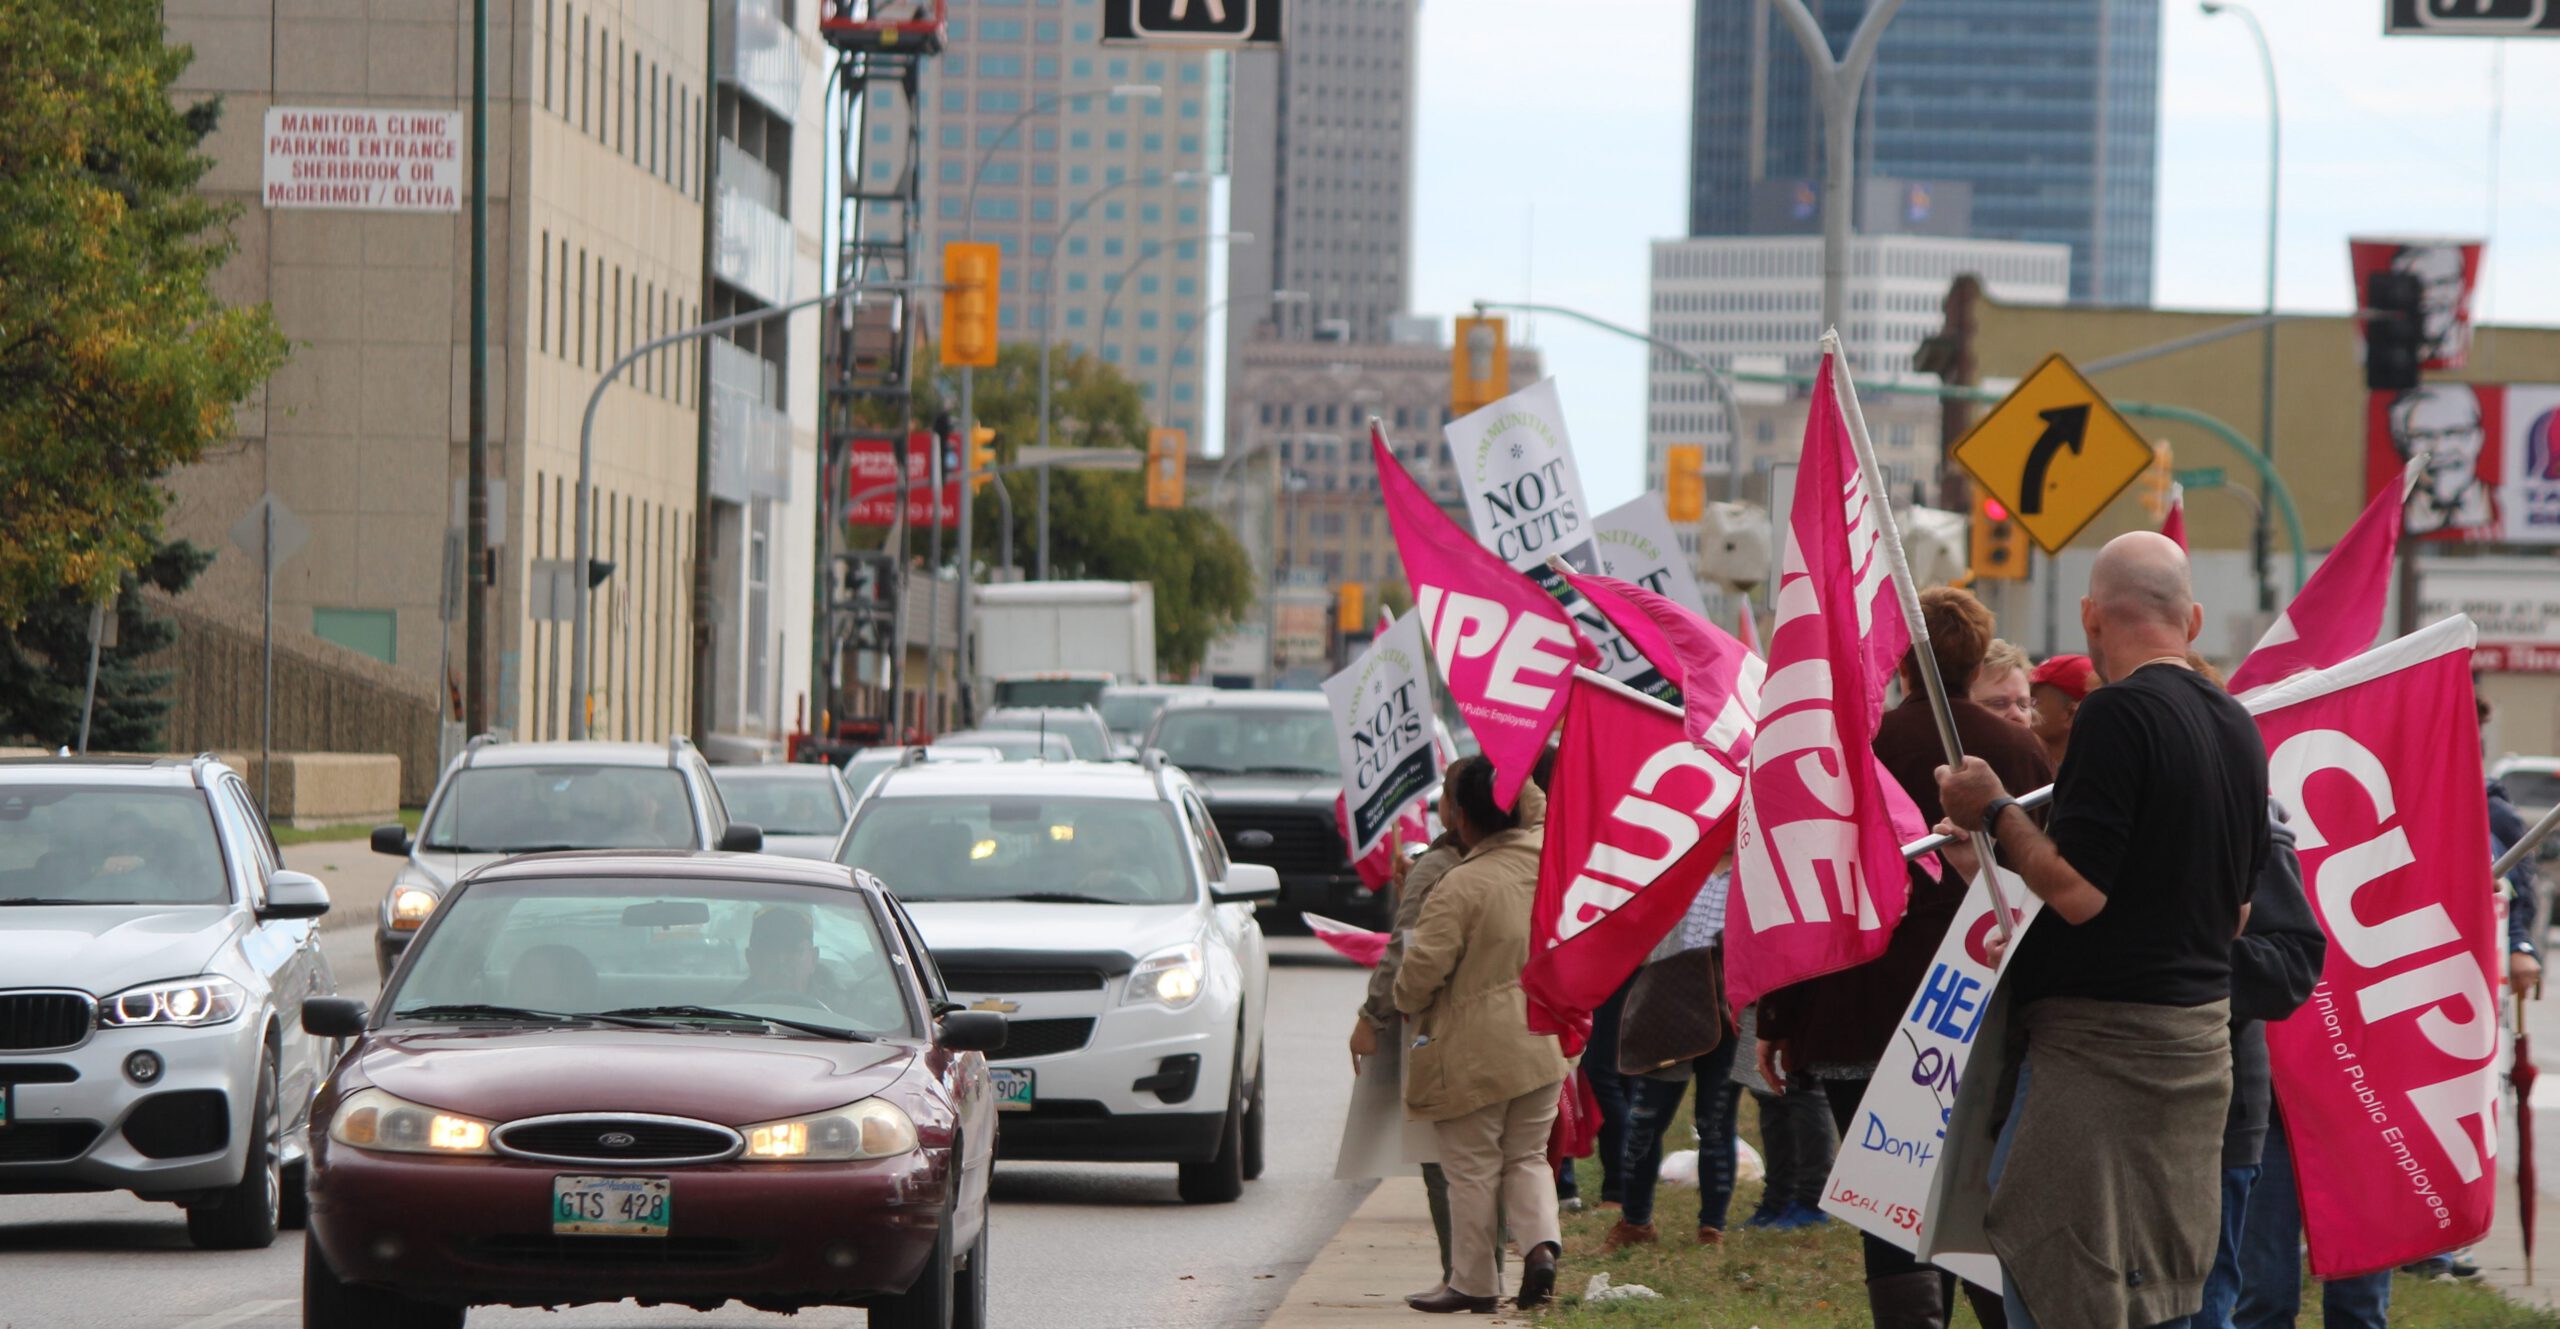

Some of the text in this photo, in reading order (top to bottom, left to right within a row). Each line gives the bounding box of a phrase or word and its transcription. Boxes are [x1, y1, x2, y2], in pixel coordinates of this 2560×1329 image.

[281, 113, 447, 136] MANITOBA CLINIC
[269, 137, 457, 160] PARKING ENTRANCE
[292, 161, 435, 182] SHERBROOK OR
[268, 183, 371, 203] McDERMOT
[394, 185, 455, 206] OLIVIA
[1483, 456, 1566, 530] NOT
[1498, 499, 1580, 563] CUTS
[1352, 677, 1416, 765] NOT
[1465, 702, 1491, 718] Public
[1491, 708, 1538, 730] Employees
[1357, 713, 1423, 791] CUTS
[2332, 1042, 2357, 1061] of
[996, 1080, 1028, 1100] 902
[2344, 1062, 2388, 1125] Public
[1862, 1111, 1935, 1169] Don't
[2381, 1124, 2452, 1230] Employees
[559, 1192, 664, 1220] GTS 428
